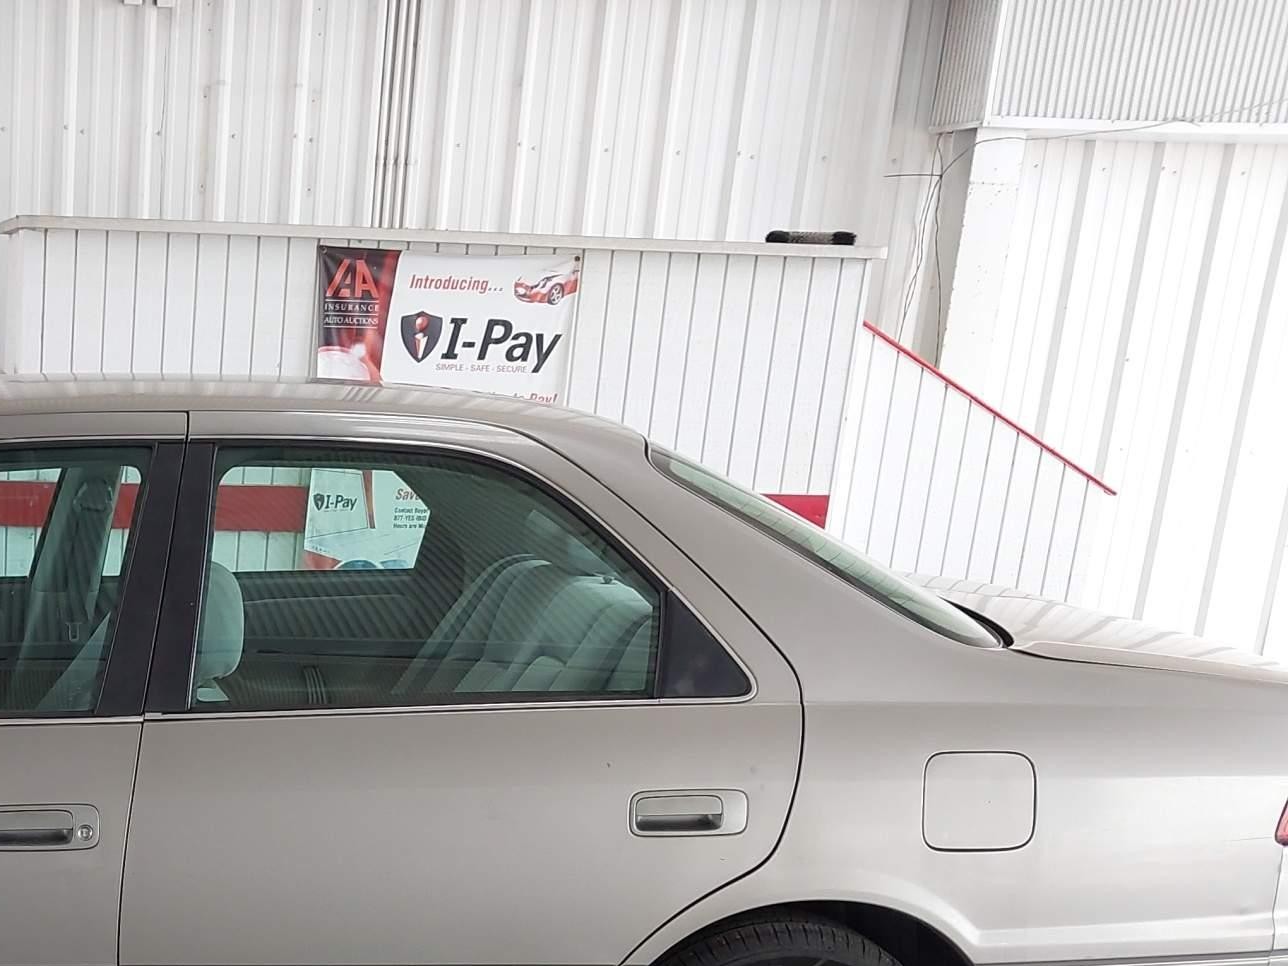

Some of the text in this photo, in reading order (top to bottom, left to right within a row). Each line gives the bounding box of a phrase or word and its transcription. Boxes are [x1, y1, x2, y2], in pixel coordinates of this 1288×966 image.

[410, 274, 504, 294] Introducing...
[324, 303, 379, 312] INSURANCE
[323, 316, 378, 325] AUTO AUCTIONS
[441, 317, 562, 373] I-Pay
[435, 363, 464, 371] SIMPLE
[470, 364, 490, 372] SAFE
[496, 365, 528, 373] SECURE
[324, 494, 358, 511] I-Pay
